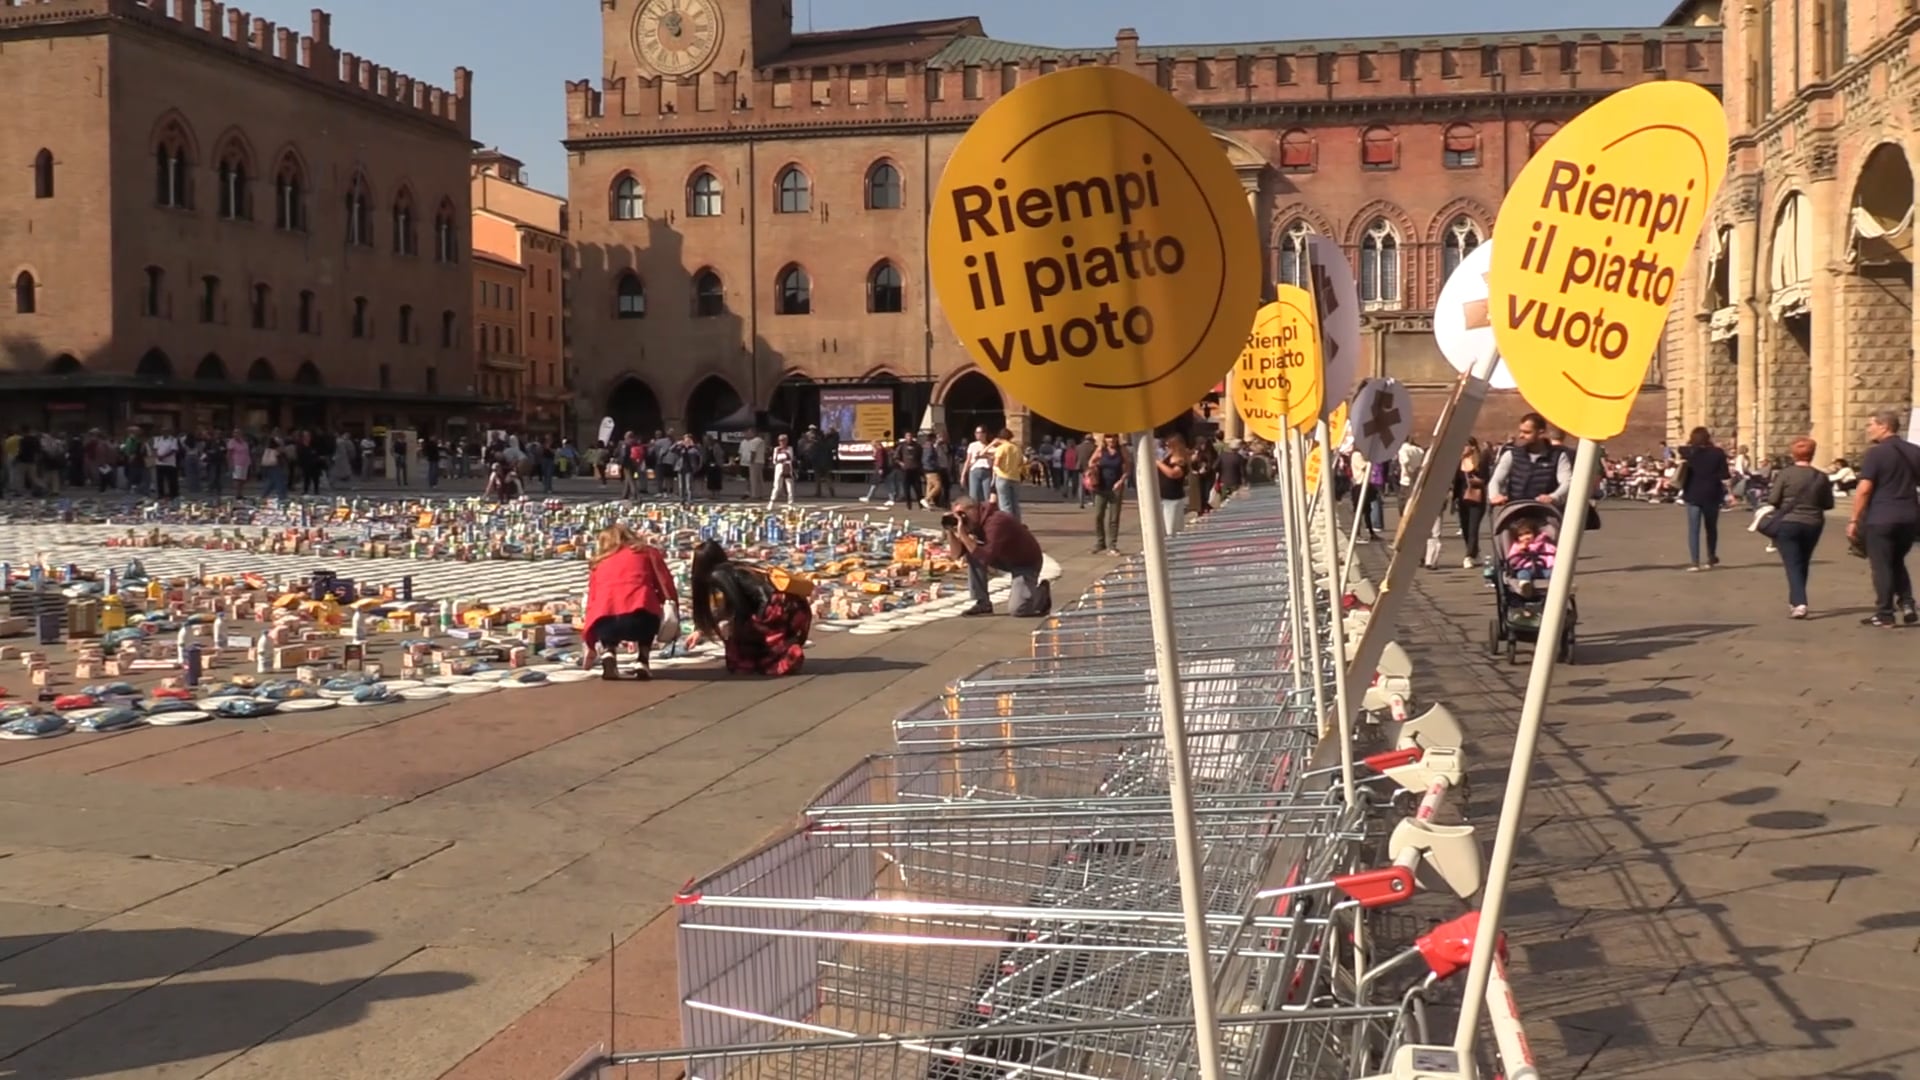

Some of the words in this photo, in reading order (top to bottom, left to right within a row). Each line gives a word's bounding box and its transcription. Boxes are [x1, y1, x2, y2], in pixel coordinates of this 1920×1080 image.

[951, 153, 1160, 242] Riempi
[1540, 160, 1695, 244] Riempi
[964, 251, 1005, 311] il
[1024, 230, 1186, 313] piatto
[1520, 221, 1557, 275] il
[1559, 236, 1675, 306] piatto
[977, 302, 1154, 373] vuoto
[1242, 353, 1253, 371] il
[1507, 294, 1629, 360] vuoto
